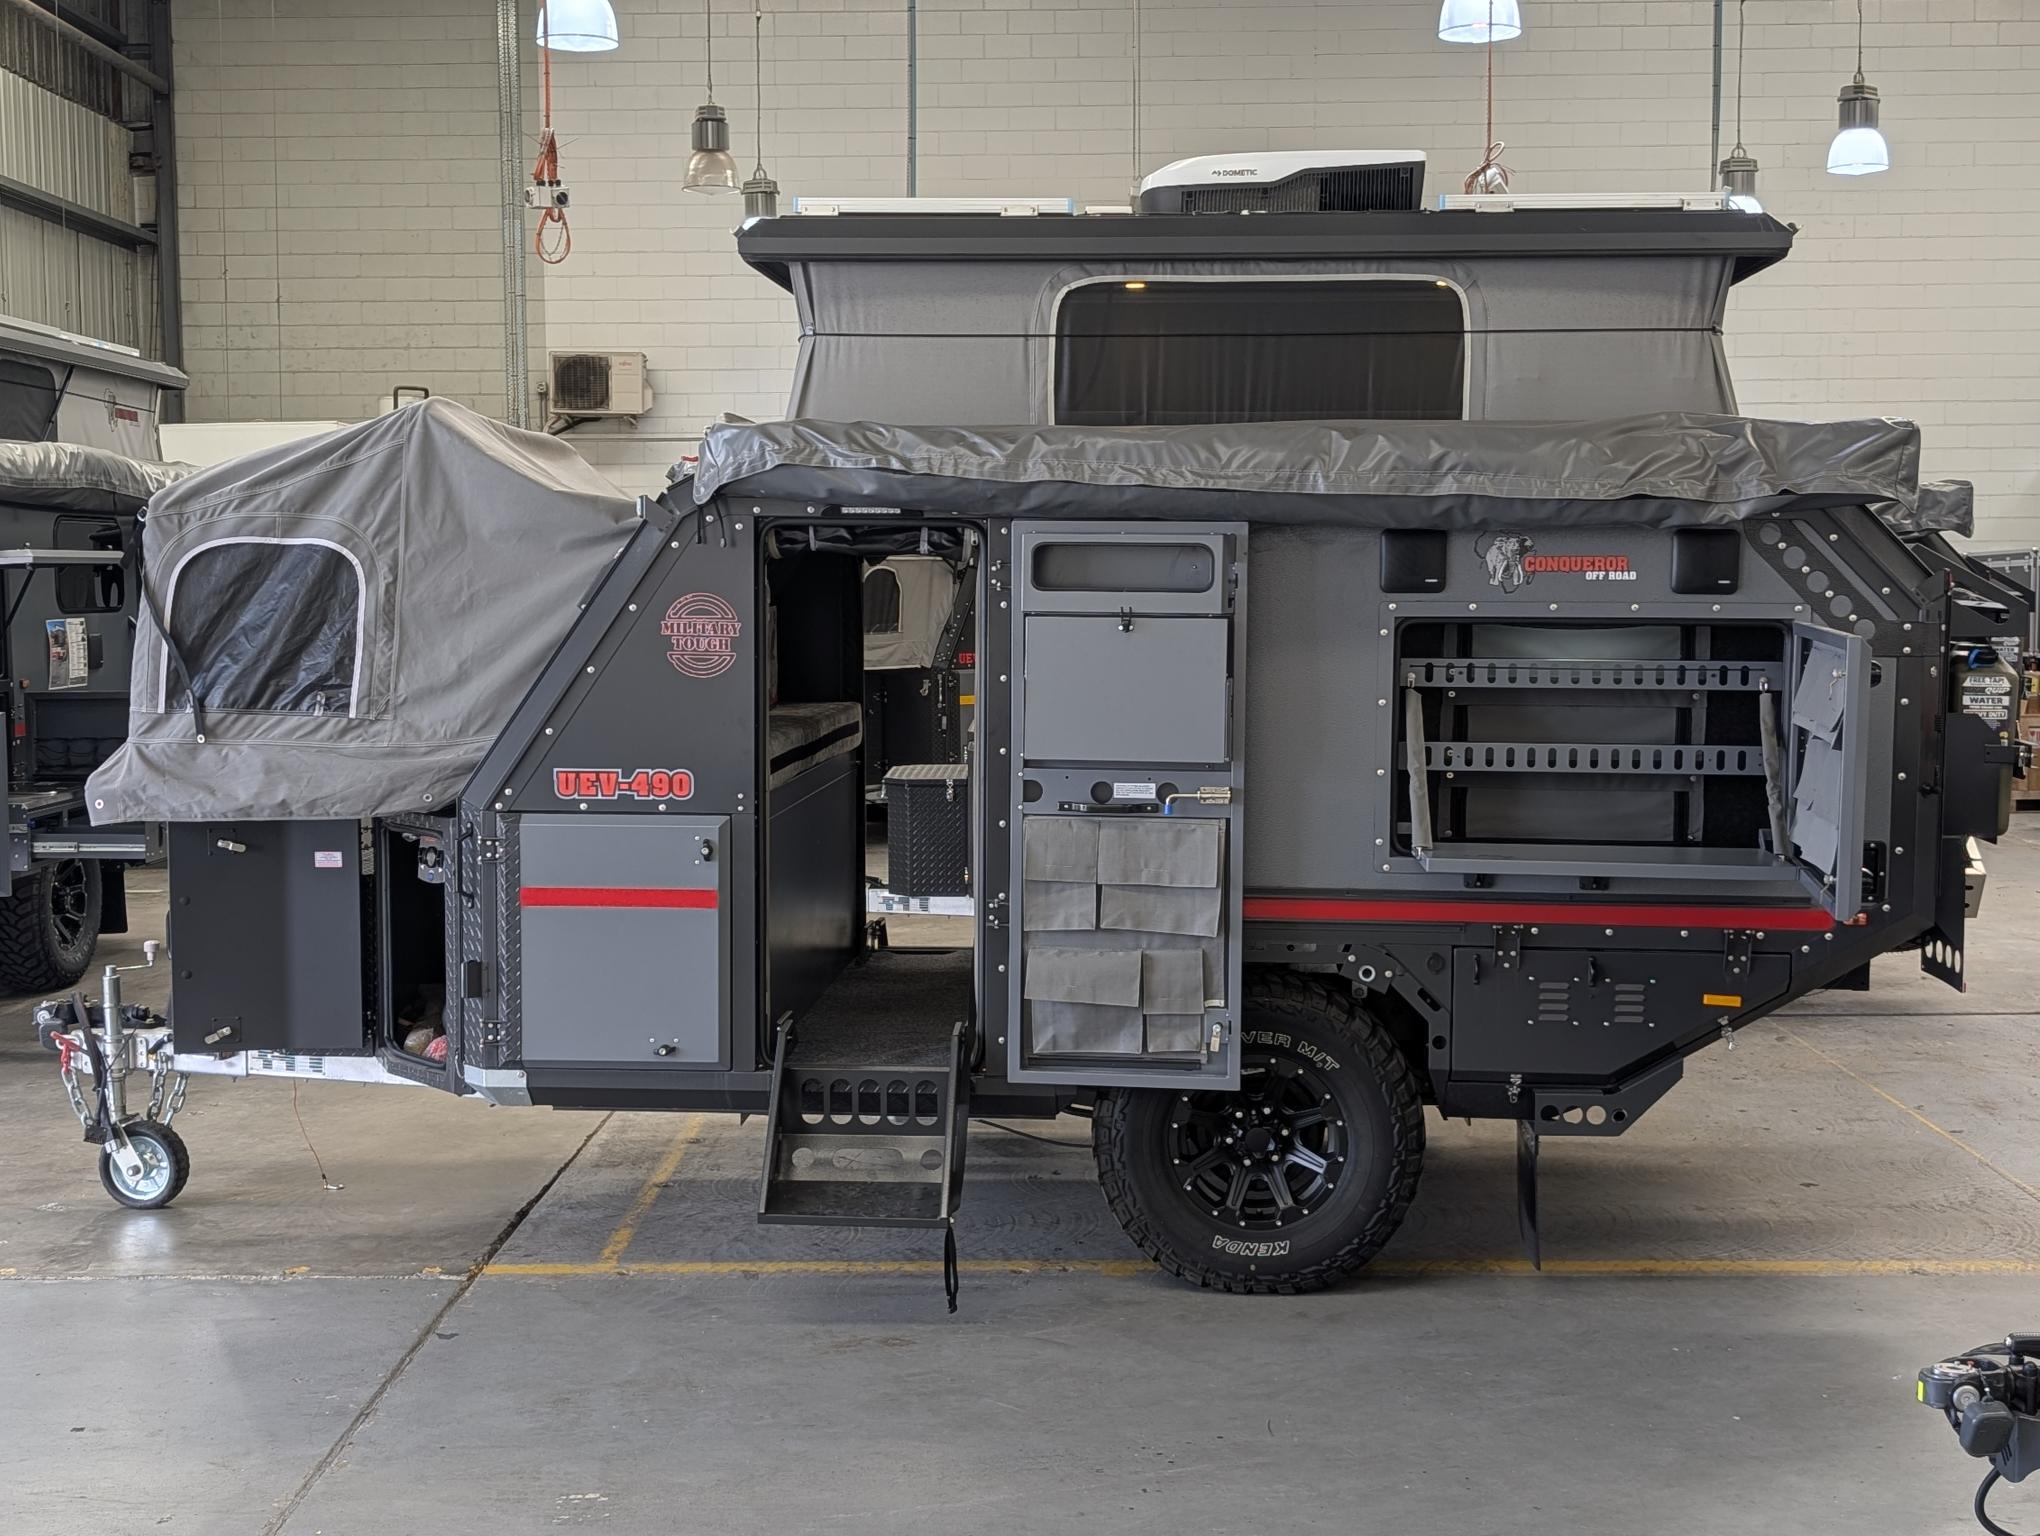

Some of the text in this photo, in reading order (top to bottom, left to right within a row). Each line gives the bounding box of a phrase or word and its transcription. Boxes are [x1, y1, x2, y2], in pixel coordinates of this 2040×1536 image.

[1222, 169, 1258, 177] DOMETIC
[1523, 555, 1630, 573] CONQUEROR
[1585, 571, 1637, 581] OFF ROAD
[661, 621, 741, 637] MILITARY
[671, 636, 731, 652] TOUGH
[1969, 697, 2003, 705] WATER
[553, 768, 694, 800] UEV-490
[1240, 1030, 1291, 1048] VER
[1212, 1234, 1290, 1257] KENDA
